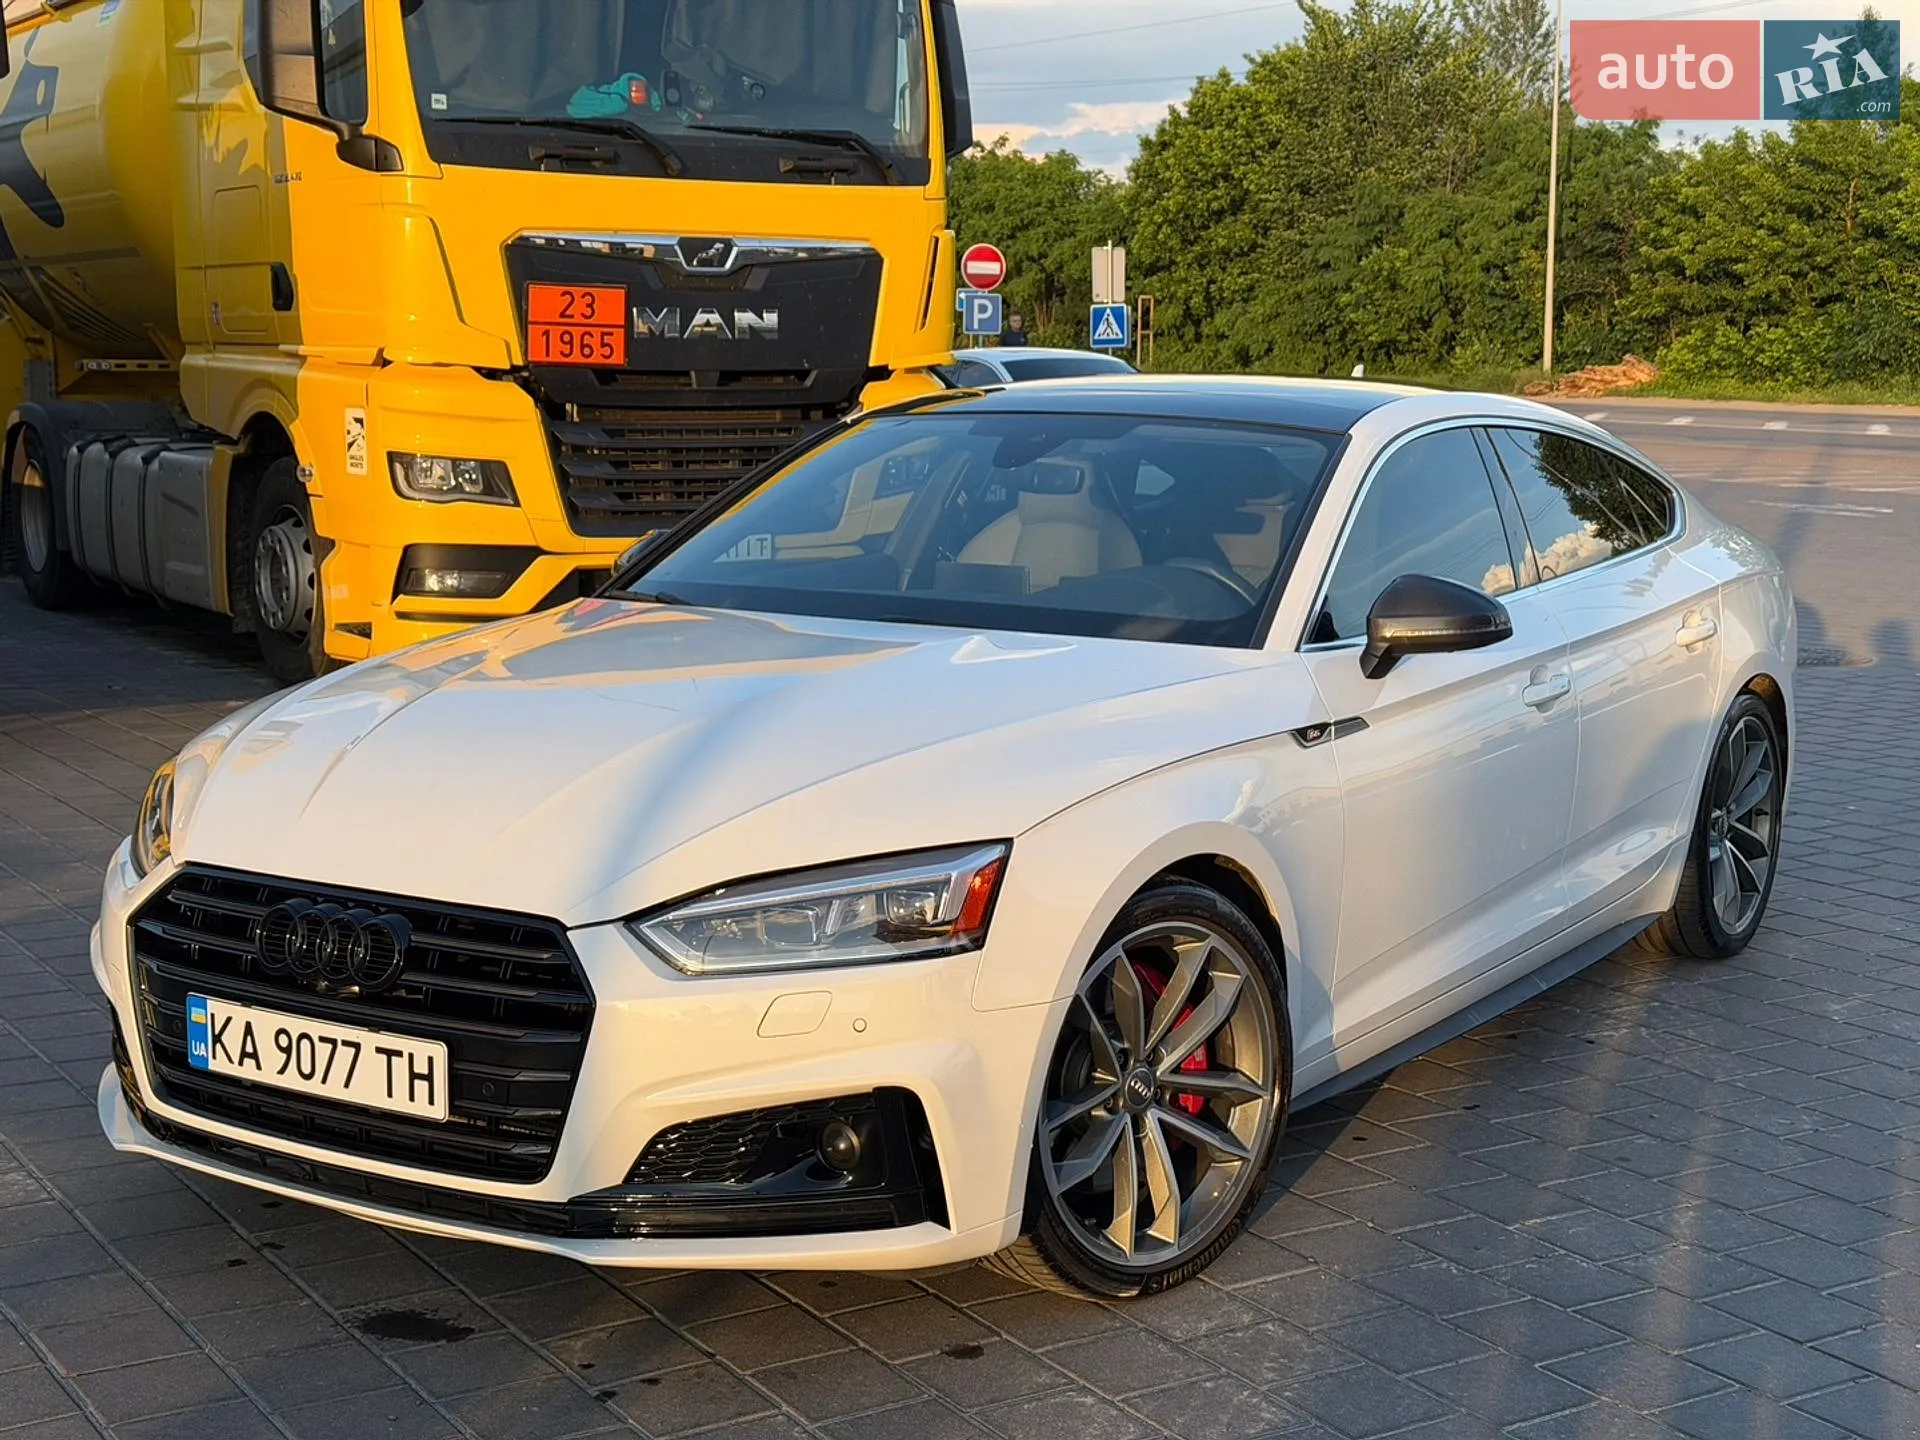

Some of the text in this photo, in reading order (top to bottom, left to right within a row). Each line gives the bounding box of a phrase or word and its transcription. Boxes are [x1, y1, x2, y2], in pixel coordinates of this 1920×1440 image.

[559, 290, 597, 320] 23
[973, 299, 993, 329] P
[632, 307, 779, 340] MAN
[541, 329, 615, 360] 1965
[192, 1040, 208, 1058] UA
[210, 1012, 435, 1106] KA 9077 TH
